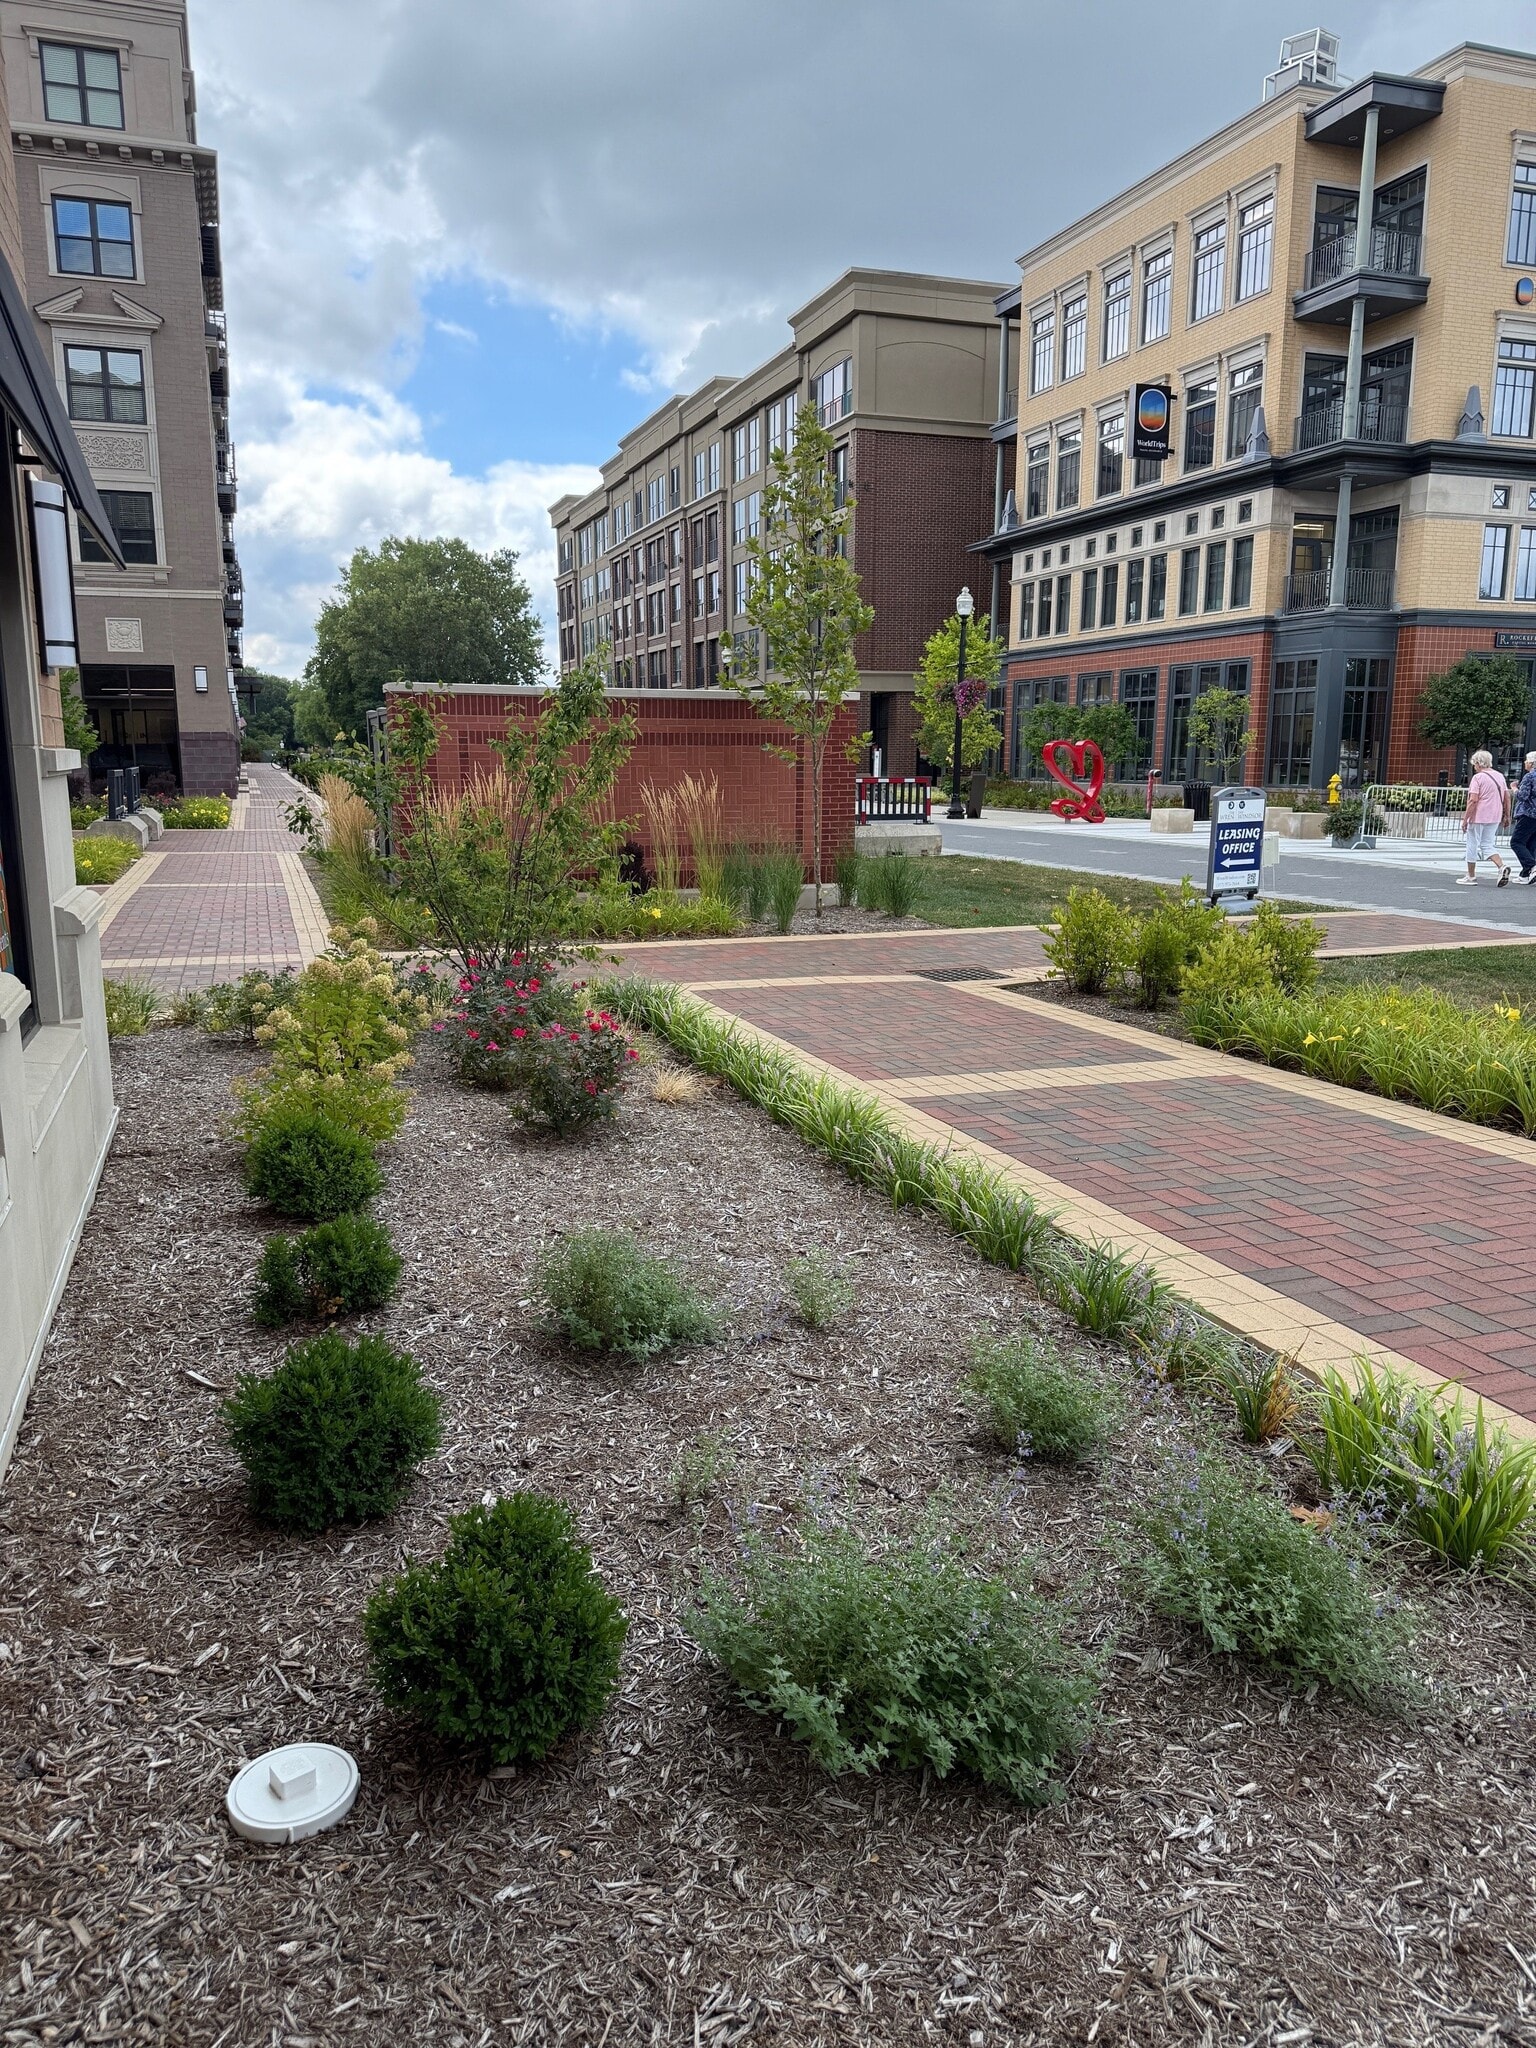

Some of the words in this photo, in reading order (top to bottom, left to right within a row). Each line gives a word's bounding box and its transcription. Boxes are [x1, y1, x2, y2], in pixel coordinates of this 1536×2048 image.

[1137, 440, 1166, 449] WorldTrips
[1237, 812, 1262, 820] WINDSOR
[1219, 828, 1260, 840] LEASING
[1222, 842, 1255, 854] OFFICE
